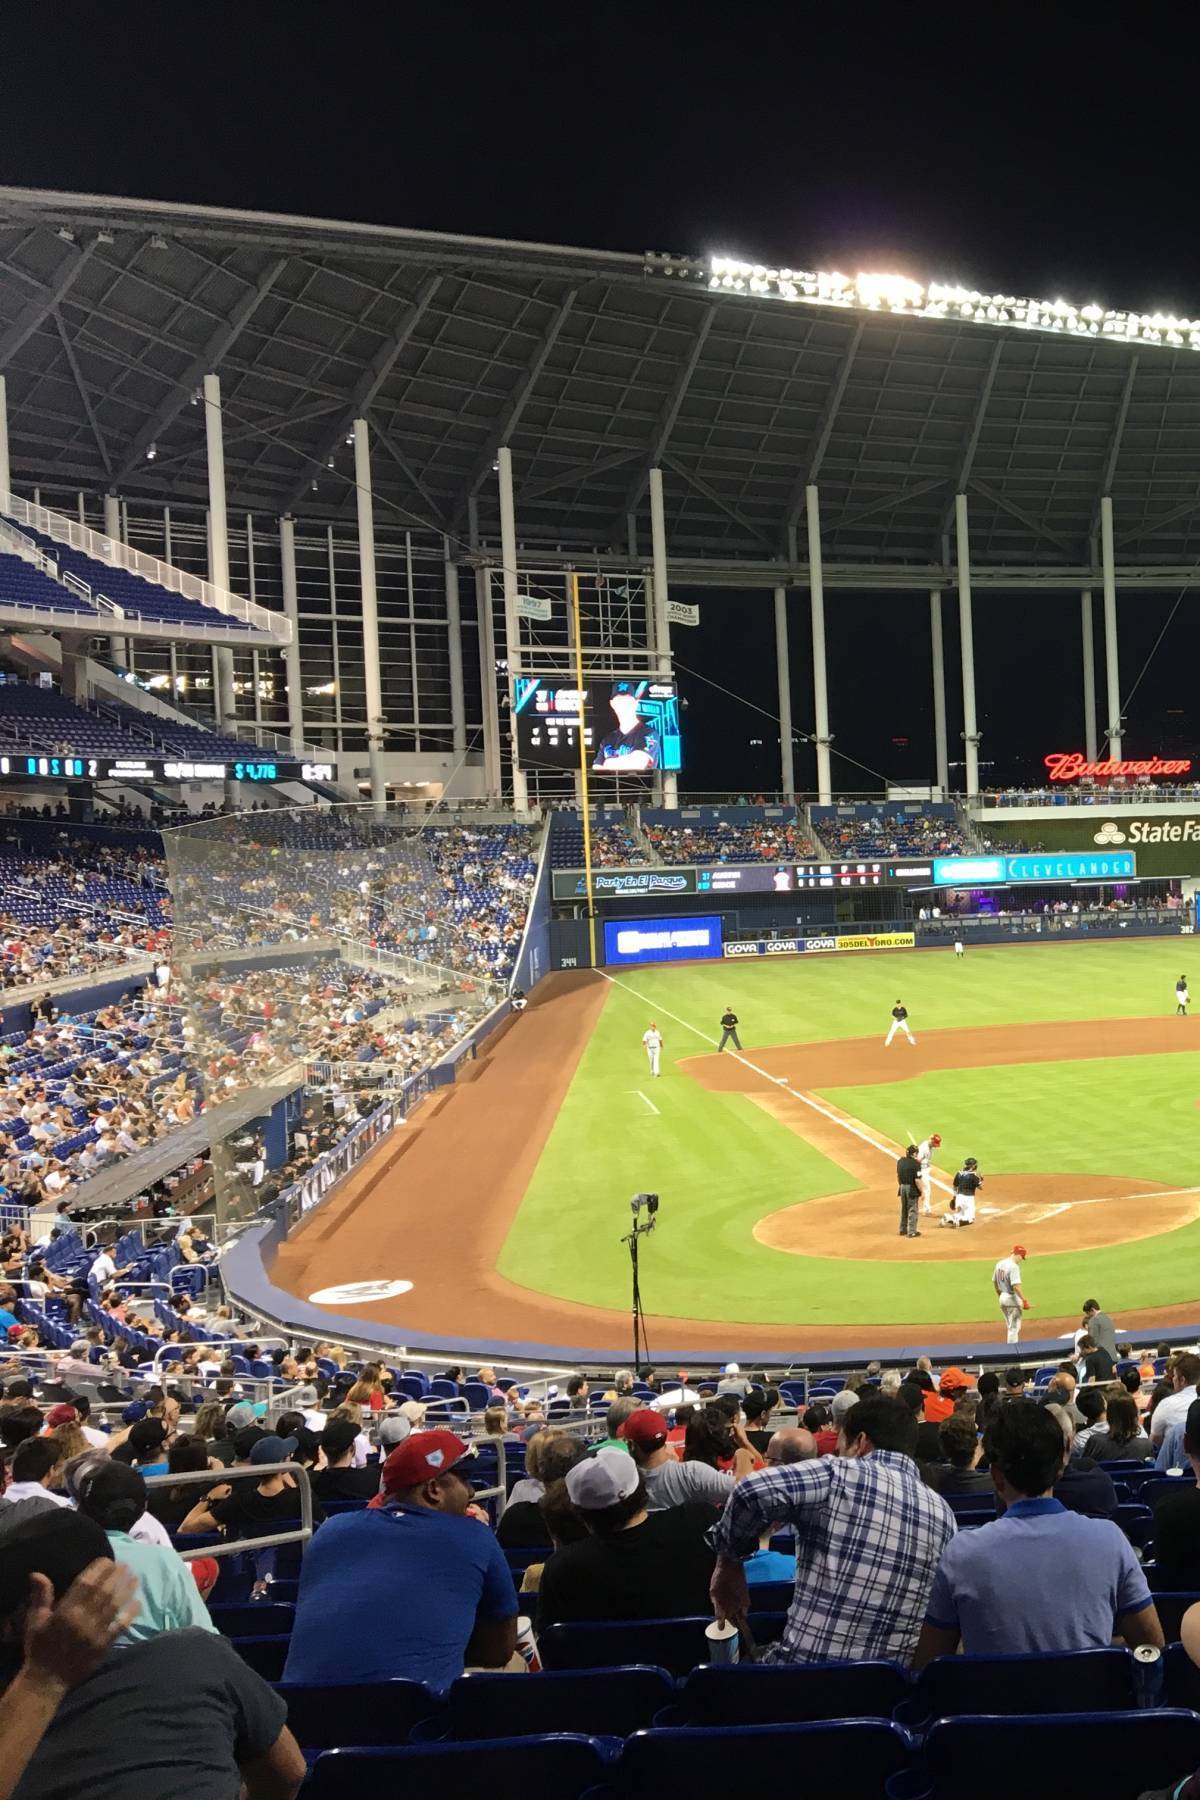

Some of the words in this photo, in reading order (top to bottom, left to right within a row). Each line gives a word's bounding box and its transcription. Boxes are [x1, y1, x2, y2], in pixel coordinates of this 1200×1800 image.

[670, 603, 693, 615] 2003
[88, 760, 97, 776] 2
[246, 764, 275, 779] 4,776
[1045, 753, 1191, 780] Budweiser
[1128, 821, 1182, 844] State
[596, 878, 624, 890] Party
[626, 877, 637, 886] En
[650, 876, 683, 888] Parque
[728, 944, 757, 954] GOYA
[767, 942, 796, 952] GOYA
[806, 940, 834, 950] GOYA
[561, 957, 577, 967] 344
